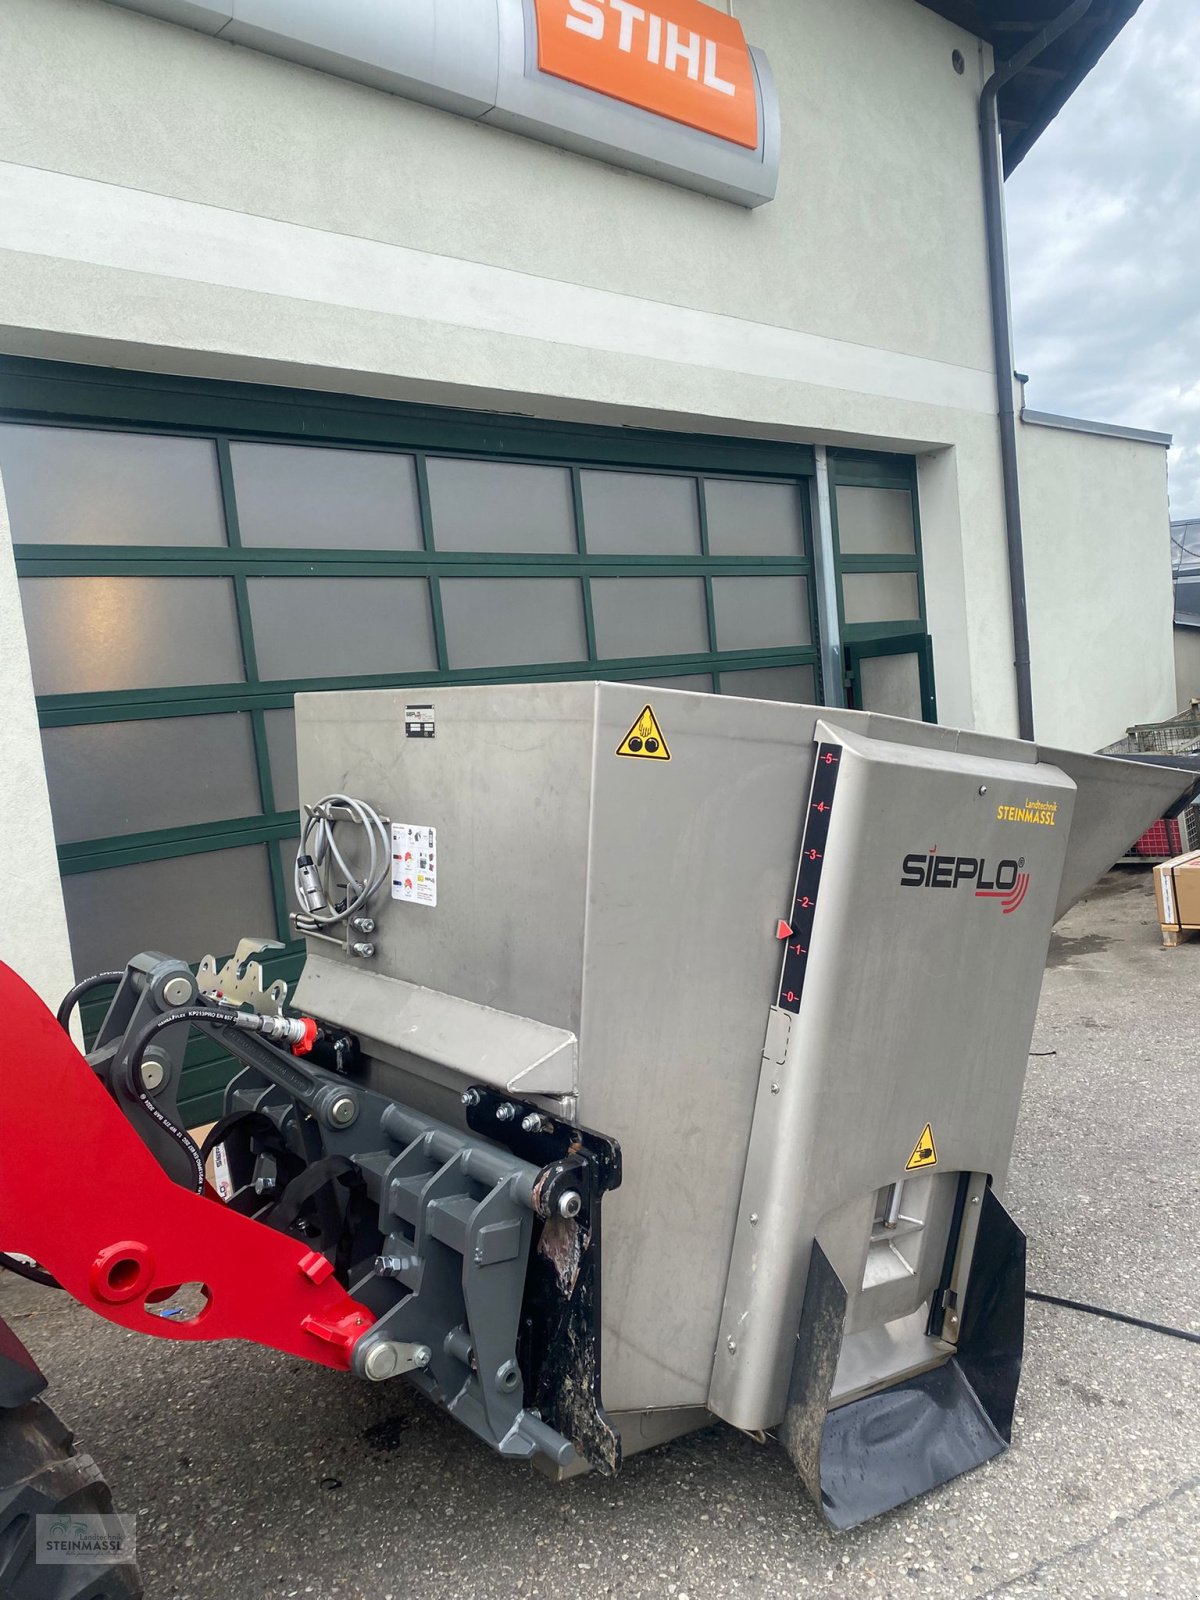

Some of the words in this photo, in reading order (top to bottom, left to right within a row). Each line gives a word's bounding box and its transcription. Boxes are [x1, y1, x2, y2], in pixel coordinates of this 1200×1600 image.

[565, 0, 736, 97] STIHL
[1025, 797, 1057, 811] Landtechnik
[996, 805, 1056, 826] STEINMASSL
